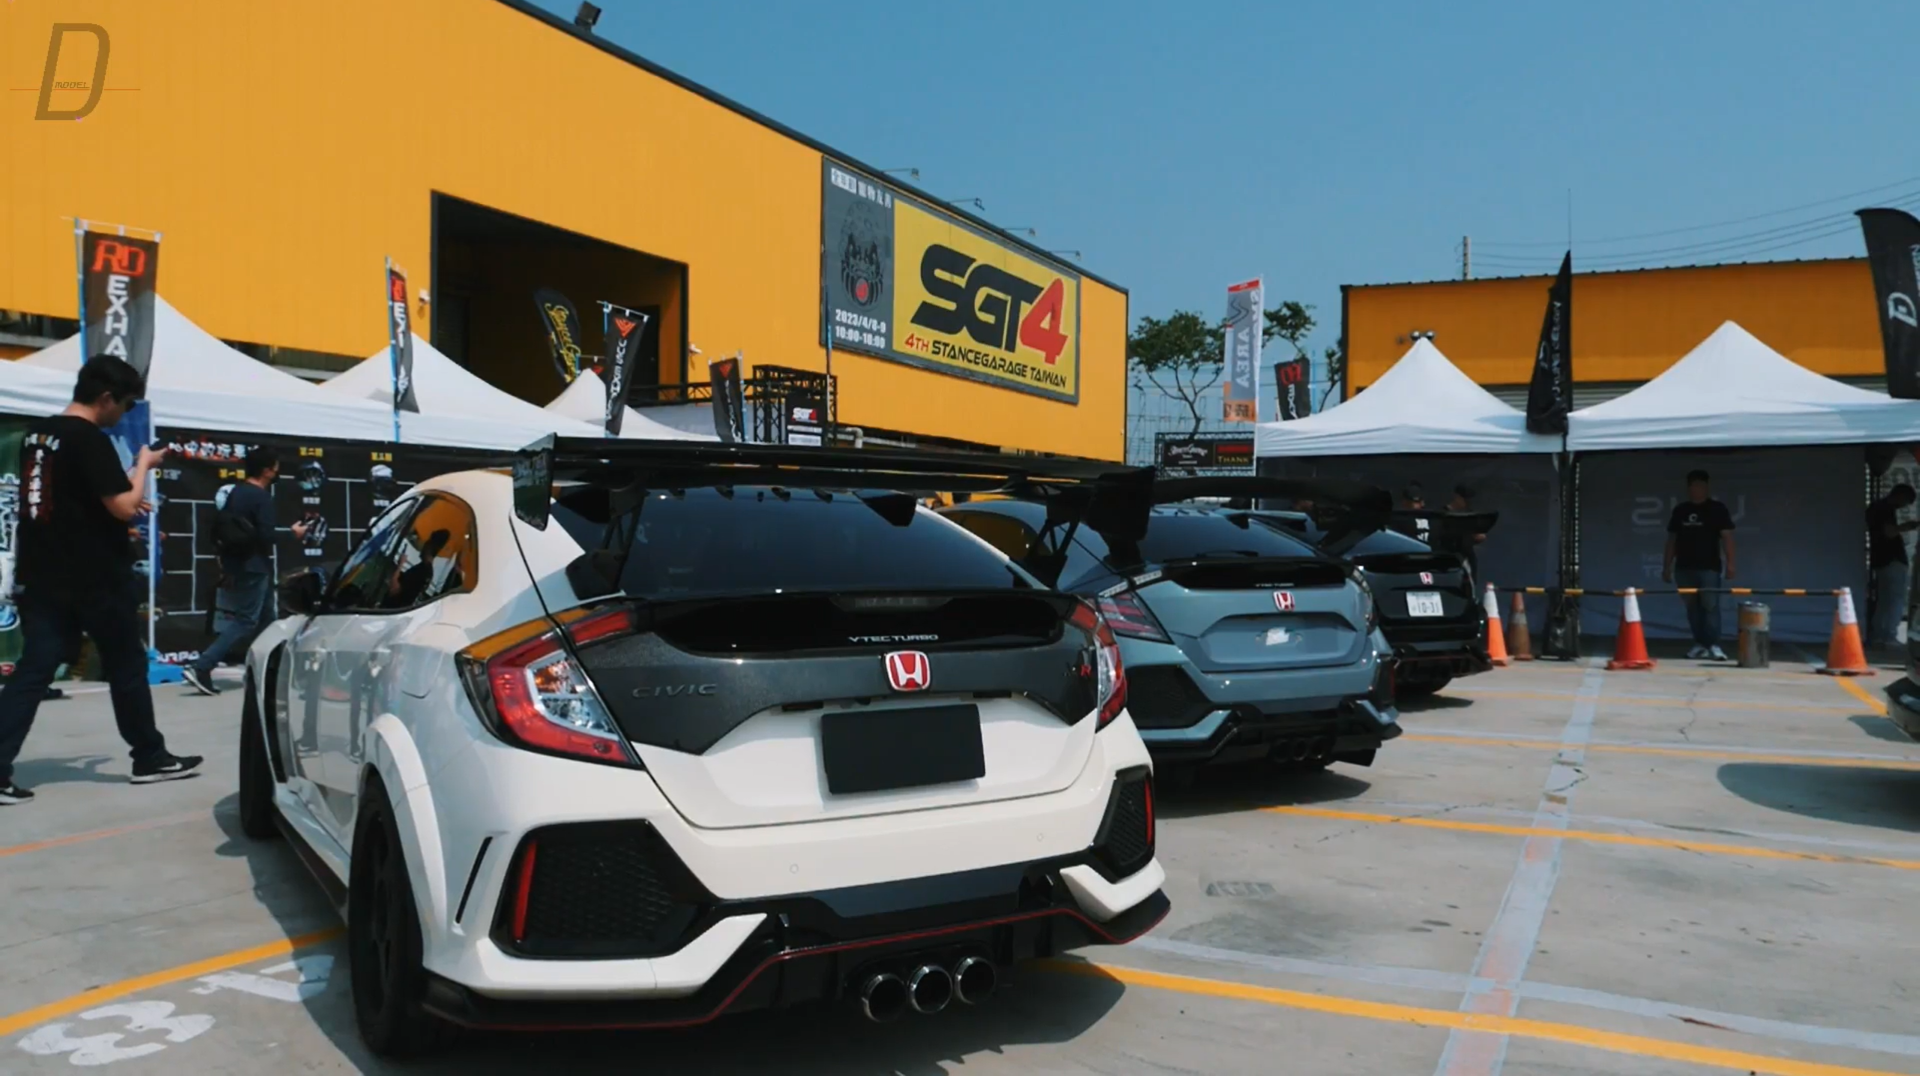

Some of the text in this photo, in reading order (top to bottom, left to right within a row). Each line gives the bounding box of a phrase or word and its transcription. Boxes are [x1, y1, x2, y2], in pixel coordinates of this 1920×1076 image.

[103, 274, 131, 363] EXHA
[910, 243, 1069, 365] SGT4
[904, 332, 1068, 389] 4TH STANCEGARAGE TAIWAN
[848, 633, 940, 643] VTEC TURBO
[631, 682, 719, 699] CIVIC
